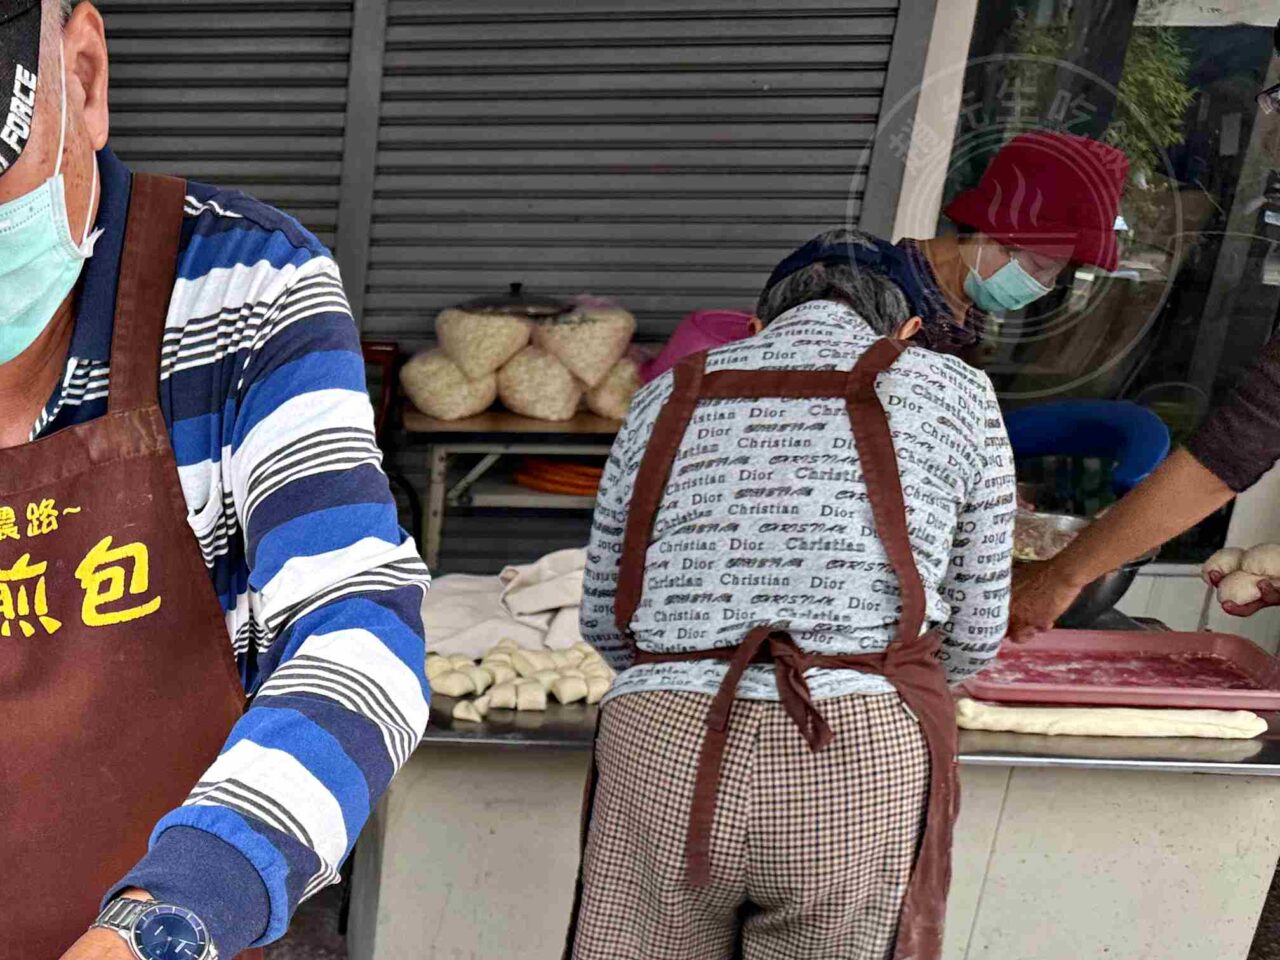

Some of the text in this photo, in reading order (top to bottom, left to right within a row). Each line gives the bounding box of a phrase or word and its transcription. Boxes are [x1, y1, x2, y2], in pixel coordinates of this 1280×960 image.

[0, 63, 38, 155] FORCE
[762, 350, 798, 362] Dior
[888, 394, 924, 414] Dior
[749, 407, 787, 419] Dior
[697, 426, 731, 440] Dior
[737, 437, 812, 449] Christian
[738, 470, 774, 482] Dior
[691, 493, 724, 506] Dior
[728, 504, 800, 516] Christian
[820, 504, 856, 519] Dior
[729, 538, 765, 551] Dior
[681, 557, 716, 571] Dior
[719, 572, 791, 587] Christian
[810, 575, 846, 591] Dior
[848, 598, 881, 613] Dior
[723, 607, 756, 621] Dior
[677, 627, 708, 641] Dior
